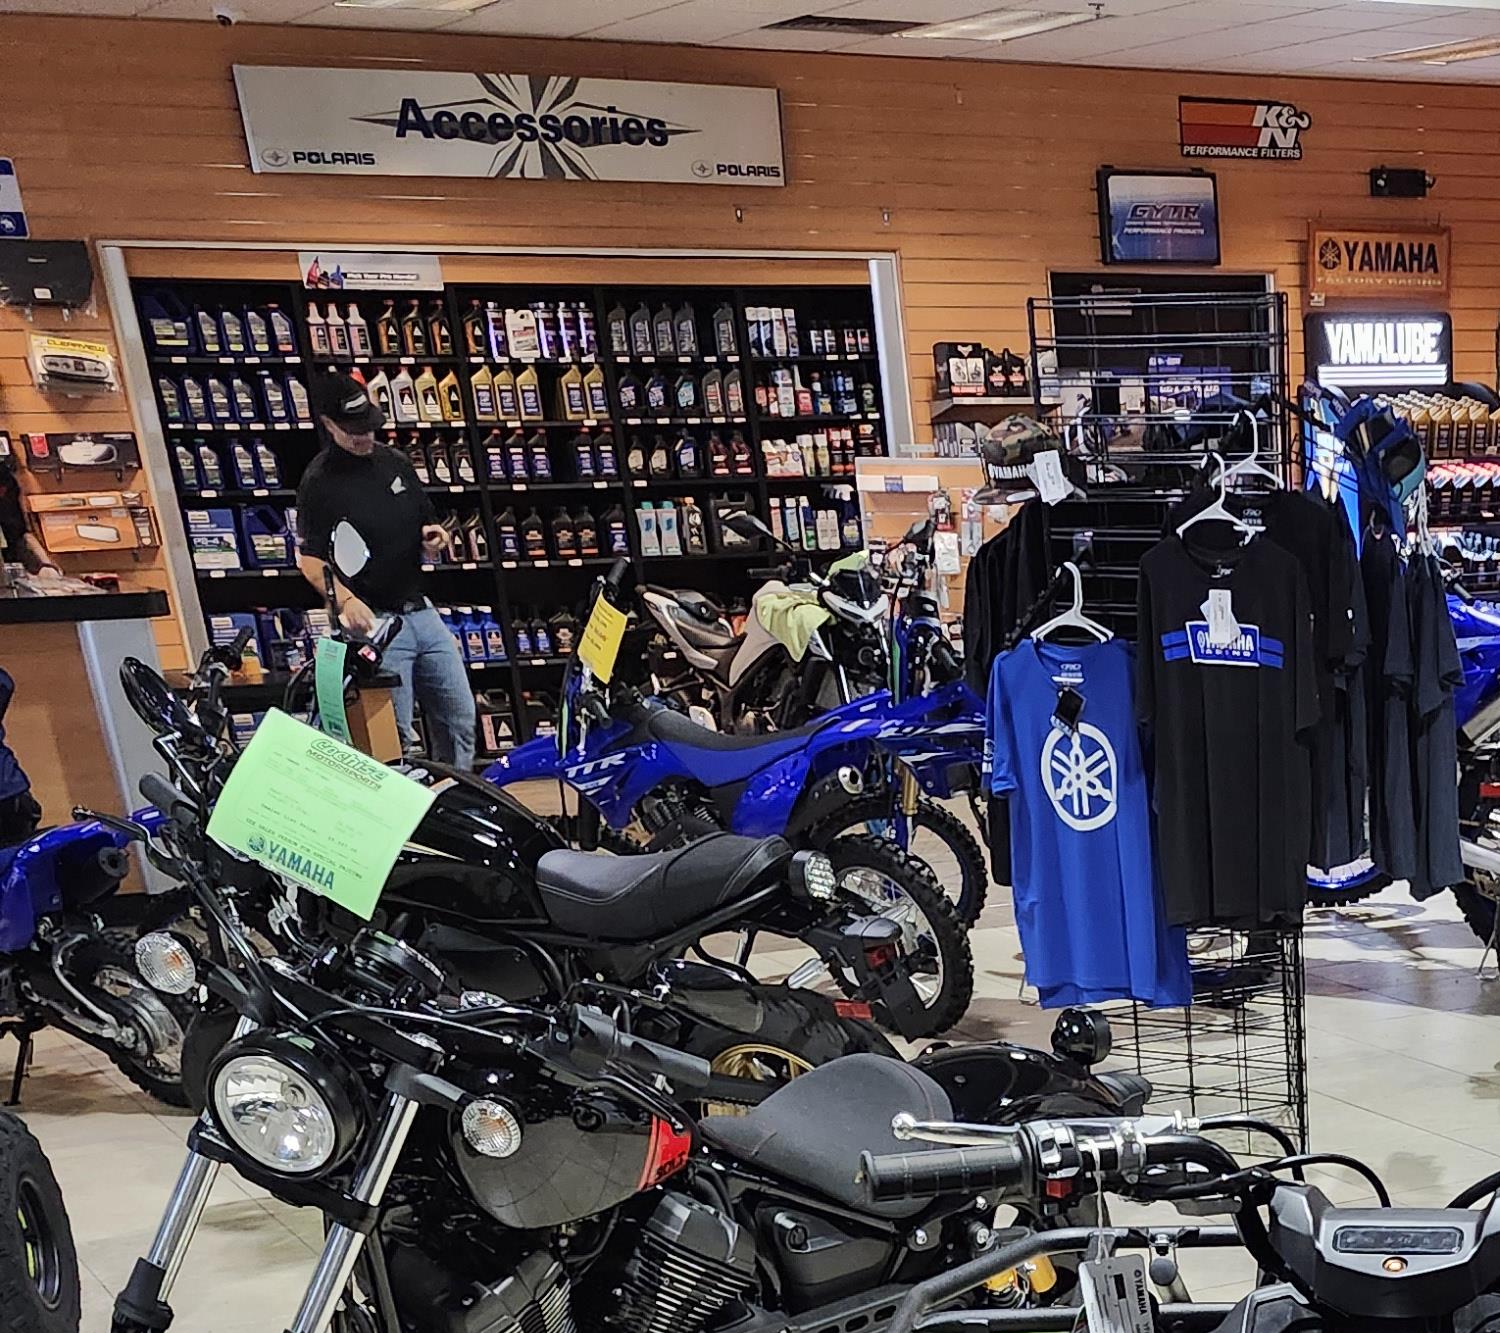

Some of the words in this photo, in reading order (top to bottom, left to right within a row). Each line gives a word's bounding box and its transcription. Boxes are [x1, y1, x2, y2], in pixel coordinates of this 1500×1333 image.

[396, 98, 669, 147] Accessories
[293, 151, 376, 165] POLARIS
[1183, 146, 1259, 157] PERFORMANCE
[1261, 148, 1301, 159] FILTERS
[716, 163, 781, 178] POLARIS
[1343, 240, 1439, 274] YAMAHA
[1324, 321, 1443, 365] YAMALUBE
[993, 464, 1028, 479] YAMAH
[306, 749, 382, 791] MOTORSPORTS
[565, 752, 627, 778] TTR
[266, 841, 335, 890] YAMAHA
[1134, 1279, 1148, 1316] YAMAHA
